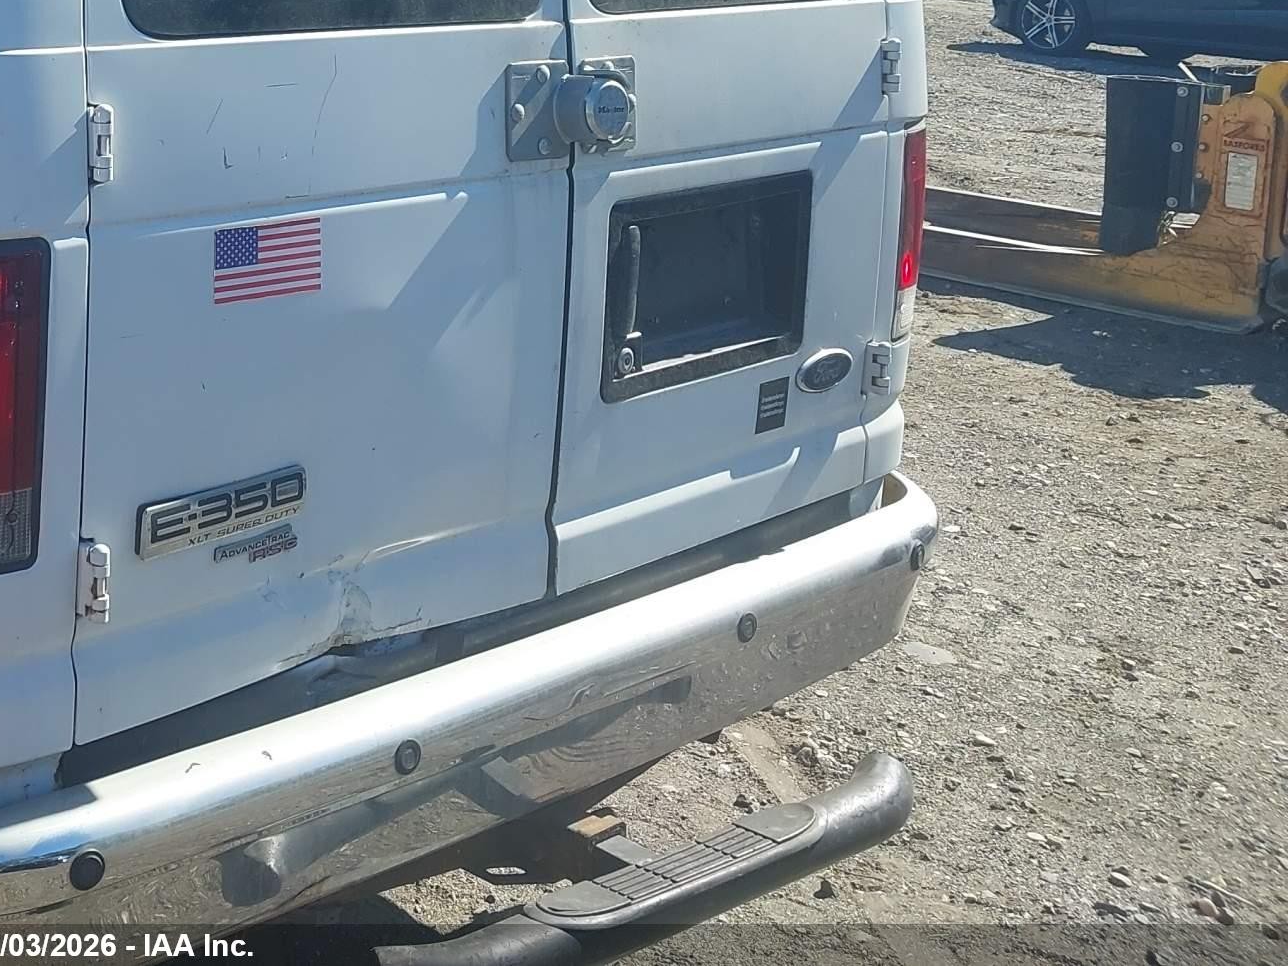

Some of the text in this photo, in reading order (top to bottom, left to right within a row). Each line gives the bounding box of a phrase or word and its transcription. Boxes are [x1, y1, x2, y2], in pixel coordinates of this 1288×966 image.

[598, 105, 625, 114] Mater
[187, 505, 301, 546] XLT SUPER DUTY
[249, 535, 298, 563] RSC
